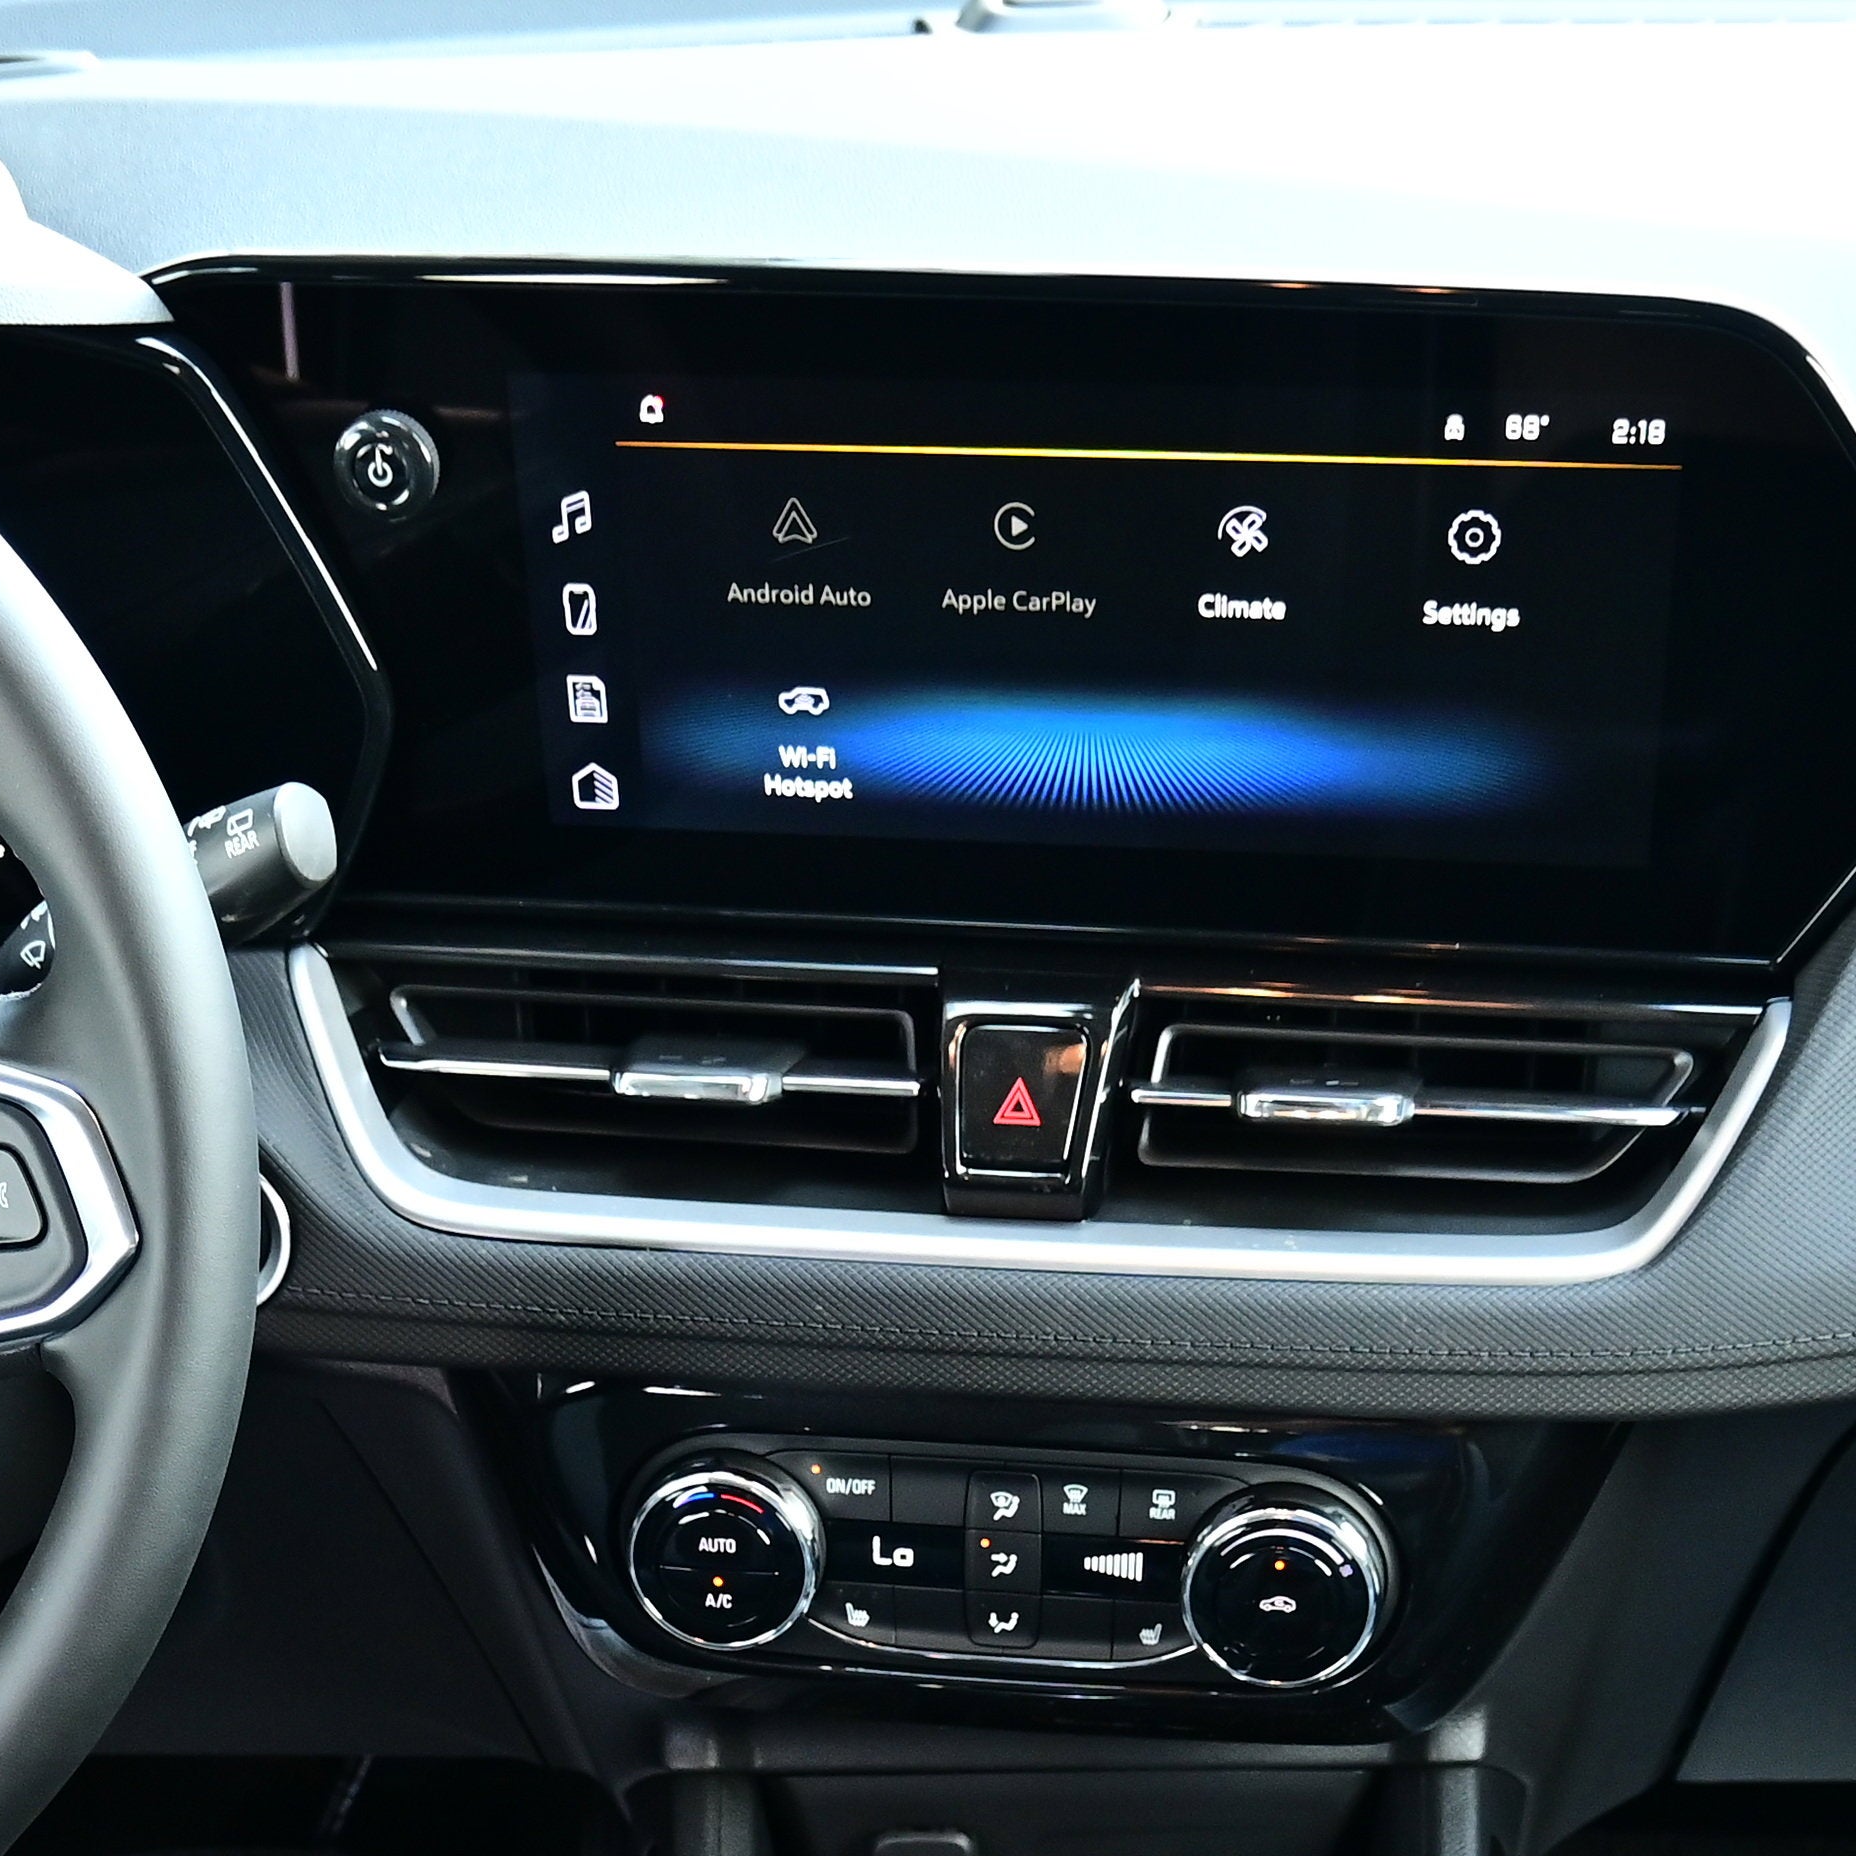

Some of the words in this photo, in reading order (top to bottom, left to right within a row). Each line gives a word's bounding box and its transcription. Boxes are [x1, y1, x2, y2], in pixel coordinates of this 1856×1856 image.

[727, 582, 813, 606] Android
[819, 584, 872, 607] Auto
[942, 586, 1008, 614] Apple
[1012, 589, 1097, 618] CarPlay
[1198, 593, 1287, 621] Climate
[1422, 600, 1520, 632] Settings
[778, 744, 836, 771] Wi-Fi
[763, 774, 853, 801] Hotspot
[224, 831, 260, 859] REAR
[826, 1478, 876, 1496] ON/OFF
[1063, 1502, 1086, 1515] MAX
[698, 1537, 736, 1553] AUTO
[705, 1593, 732, 1609] A/C
